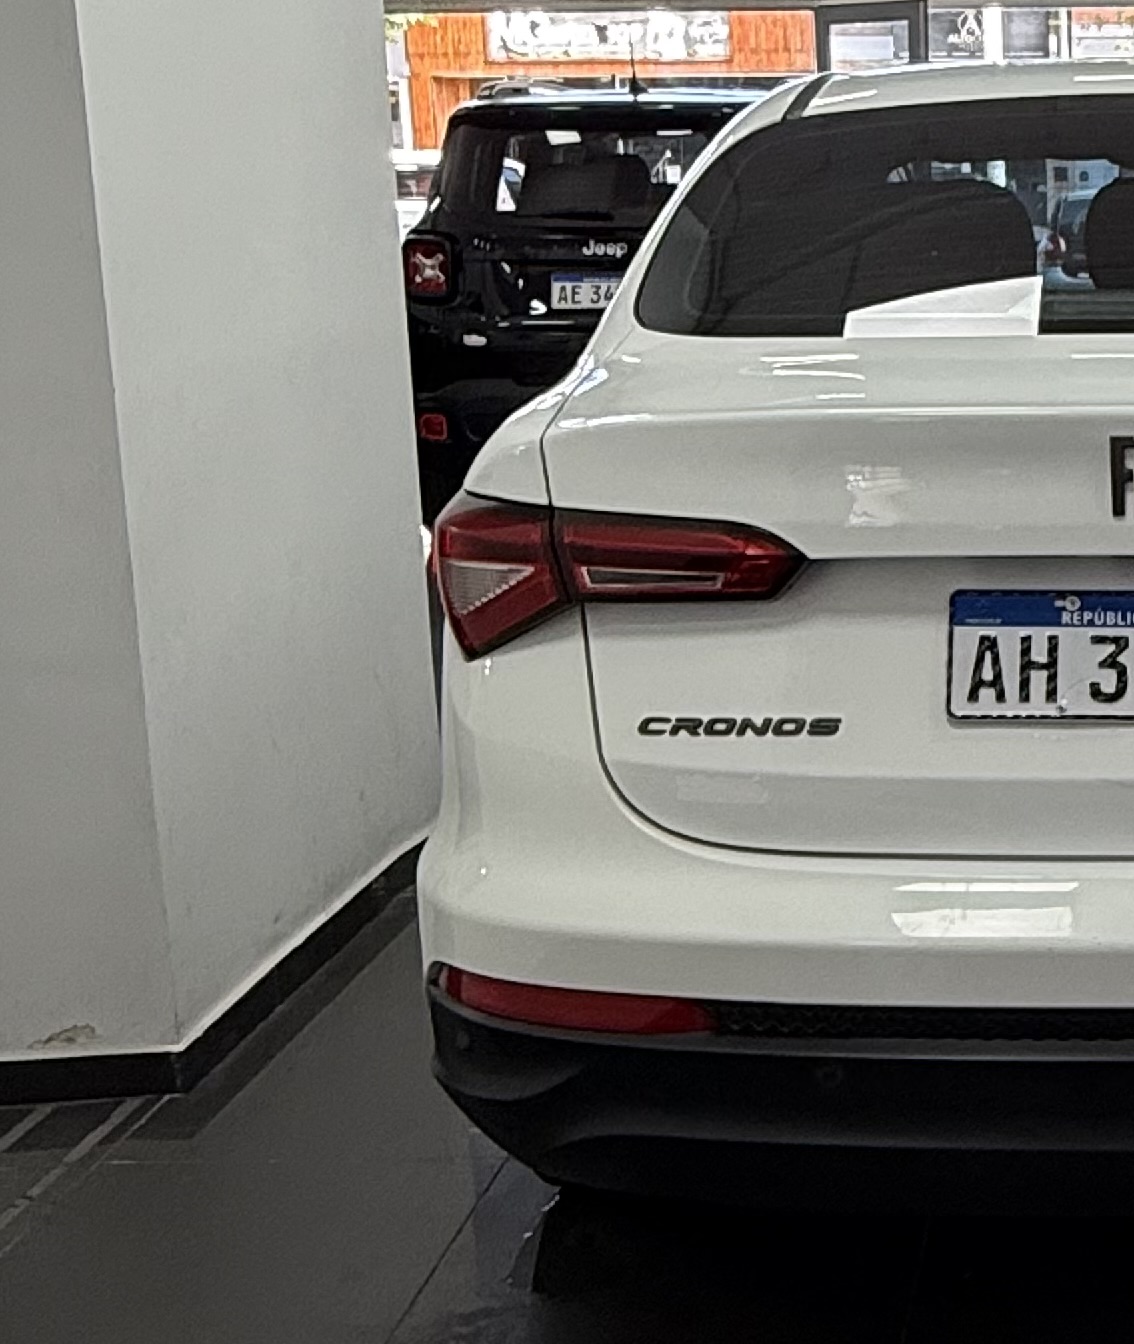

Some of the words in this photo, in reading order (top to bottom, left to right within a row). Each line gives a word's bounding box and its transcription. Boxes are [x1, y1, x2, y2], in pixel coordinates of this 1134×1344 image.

[582, 239, 628, 259] Jeep
[557, 285, 582, 304] AE
[967, 634, 1060, 704] AH
[637, 716, 842, 737] CRONOS
